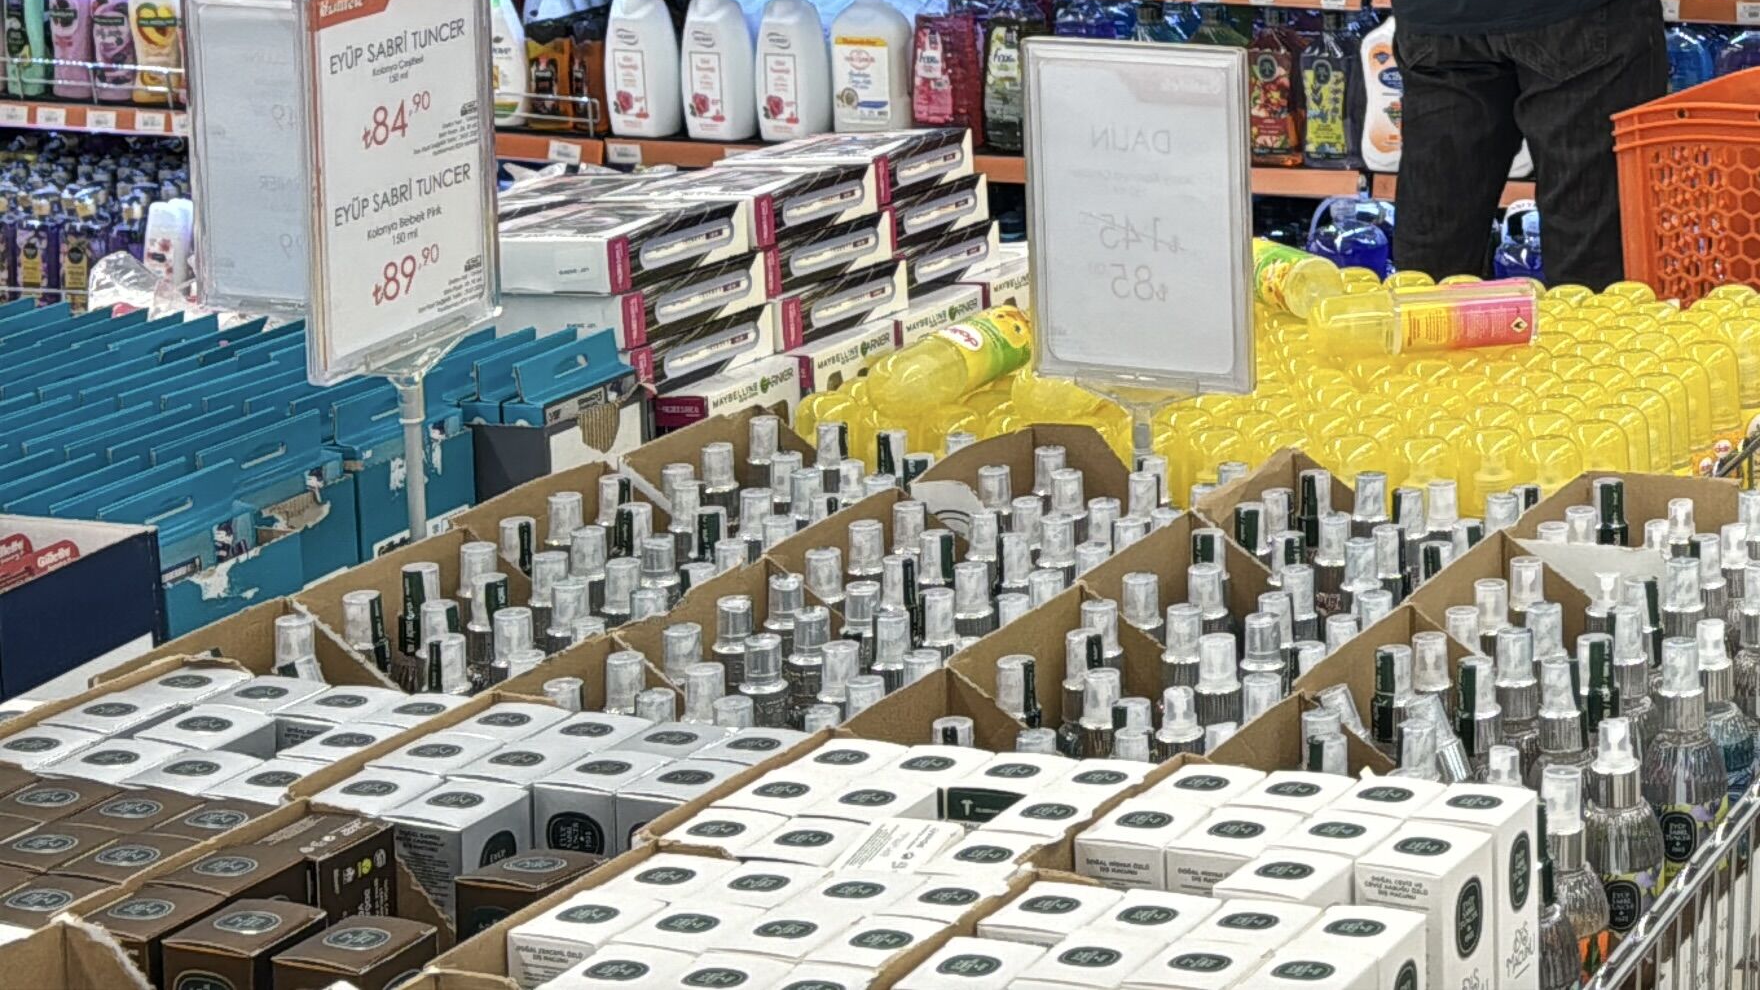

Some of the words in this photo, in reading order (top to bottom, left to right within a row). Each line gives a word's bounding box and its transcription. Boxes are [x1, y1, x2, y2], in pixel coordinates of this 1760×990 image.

[329, 44, 364, 75] EYÜP
[366, 30, 408, 63] SABRİ
[412, 18, 466, 51] TUNCER
[334, 195, 370, 228] EYÜP
[372, 177, 413, 213] SABRİ
[416, 162, 471, 198] TUNCER
[366, 221, 398, 242] Kolonya
[392, 232, 406, 246] 150
[407, 227, 419, 241] ml
[993, 272, 1030, 294] MAYBELLIN
[905, 309, 948, 334] MAYBELLINE
[817, 345, 860, 371] MAYBELLINE
[712, 382, 758, 410] MAYBELLINE
[760, 366, 794, 393] GARNIER
